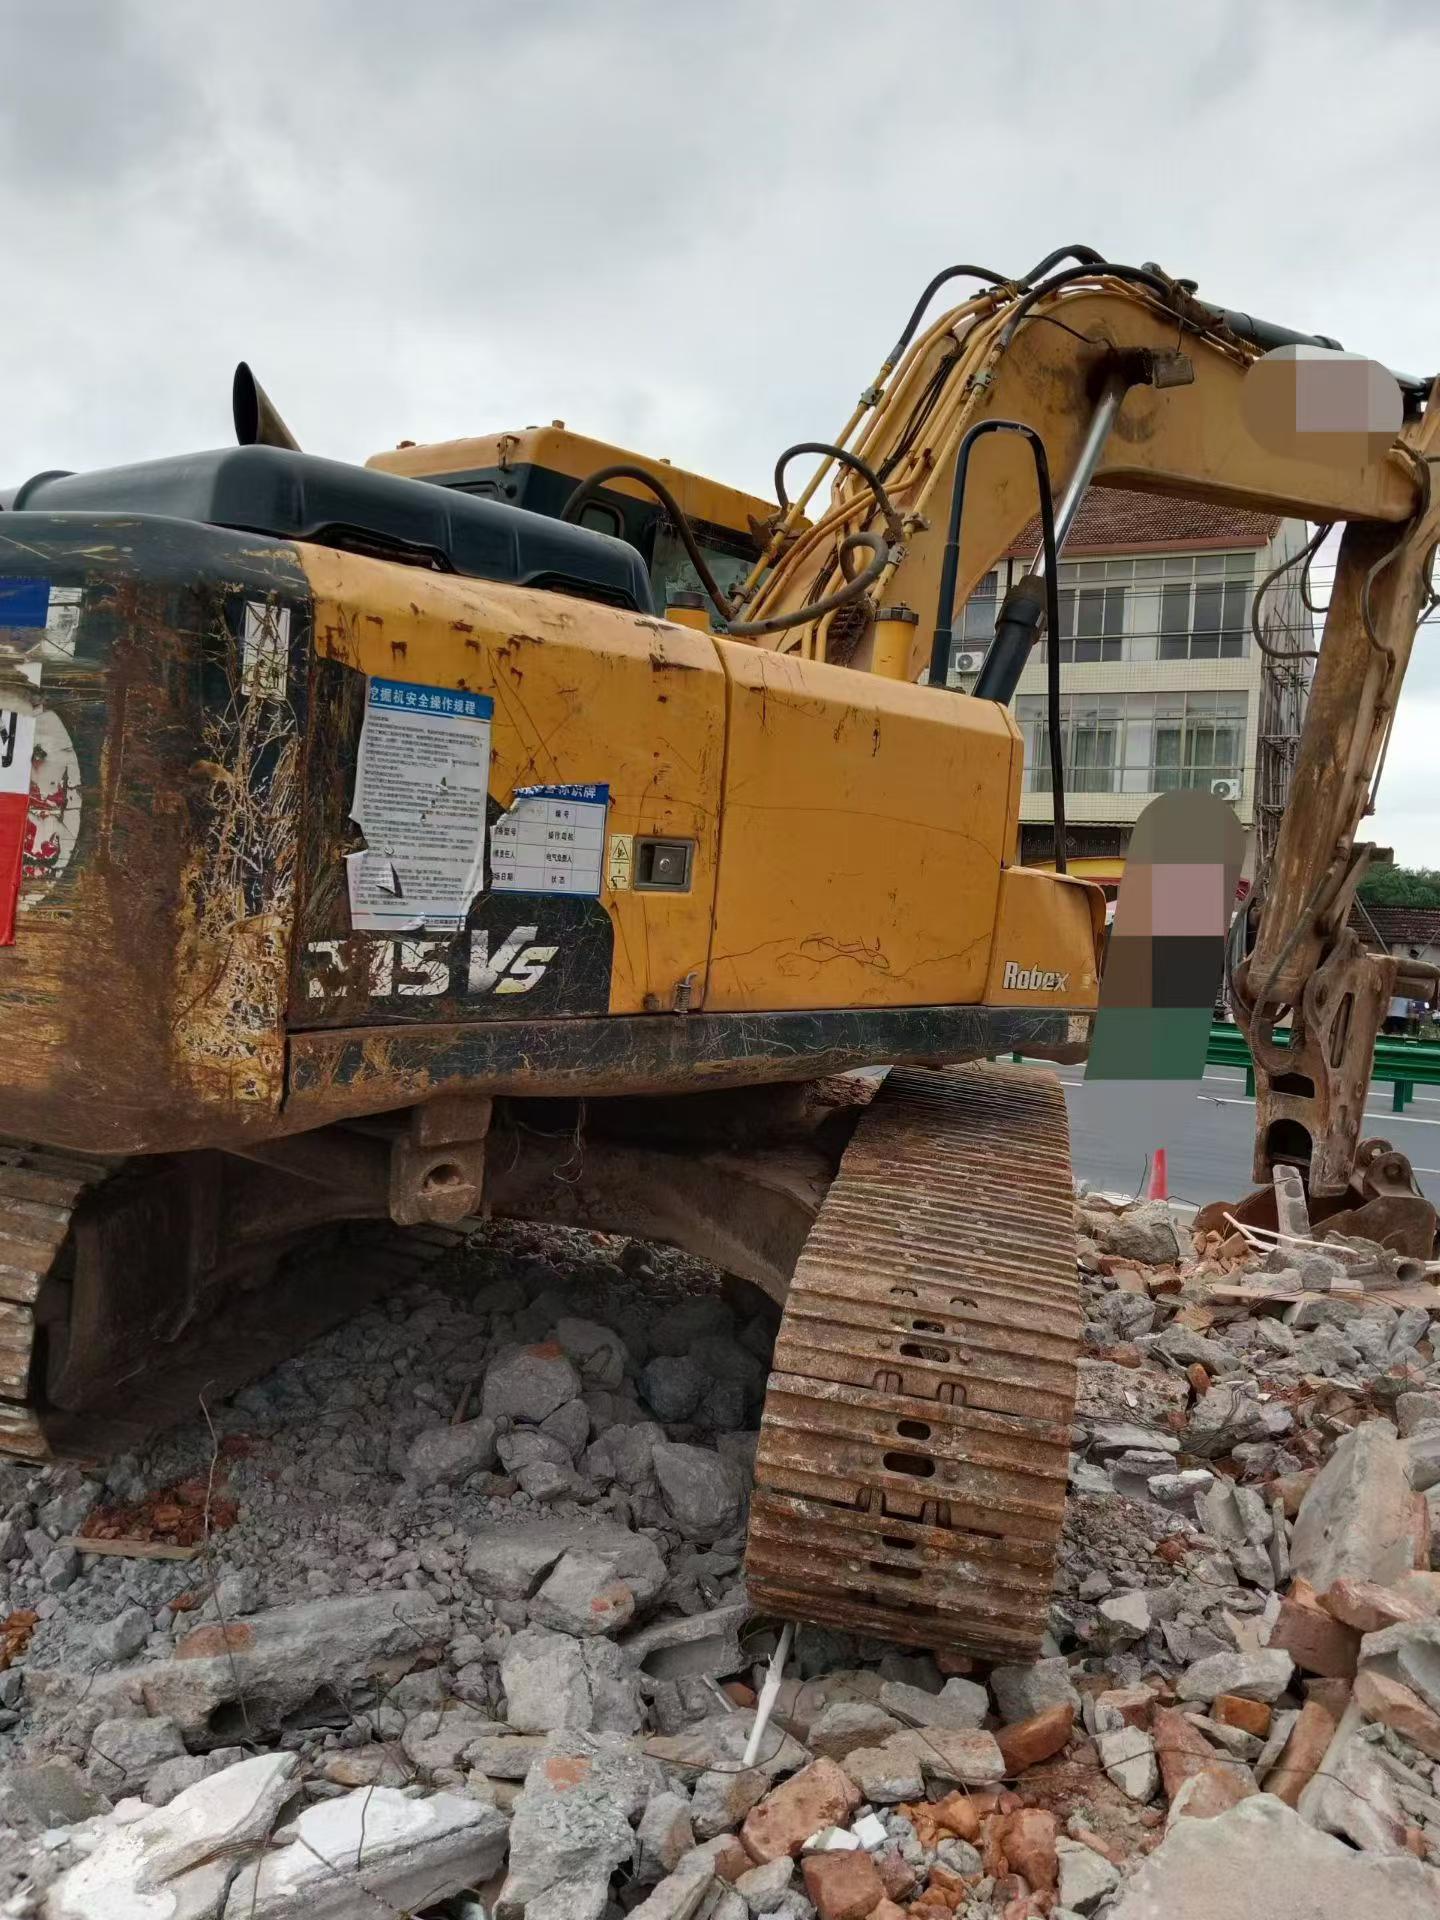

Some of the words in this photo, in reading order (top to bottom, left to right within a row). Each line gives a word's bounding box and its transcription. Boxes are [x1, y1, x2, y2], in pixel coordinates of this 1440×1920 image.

[489, 872, 513, 881] 场日期
[1003, 960, 1070, 992] Robex
